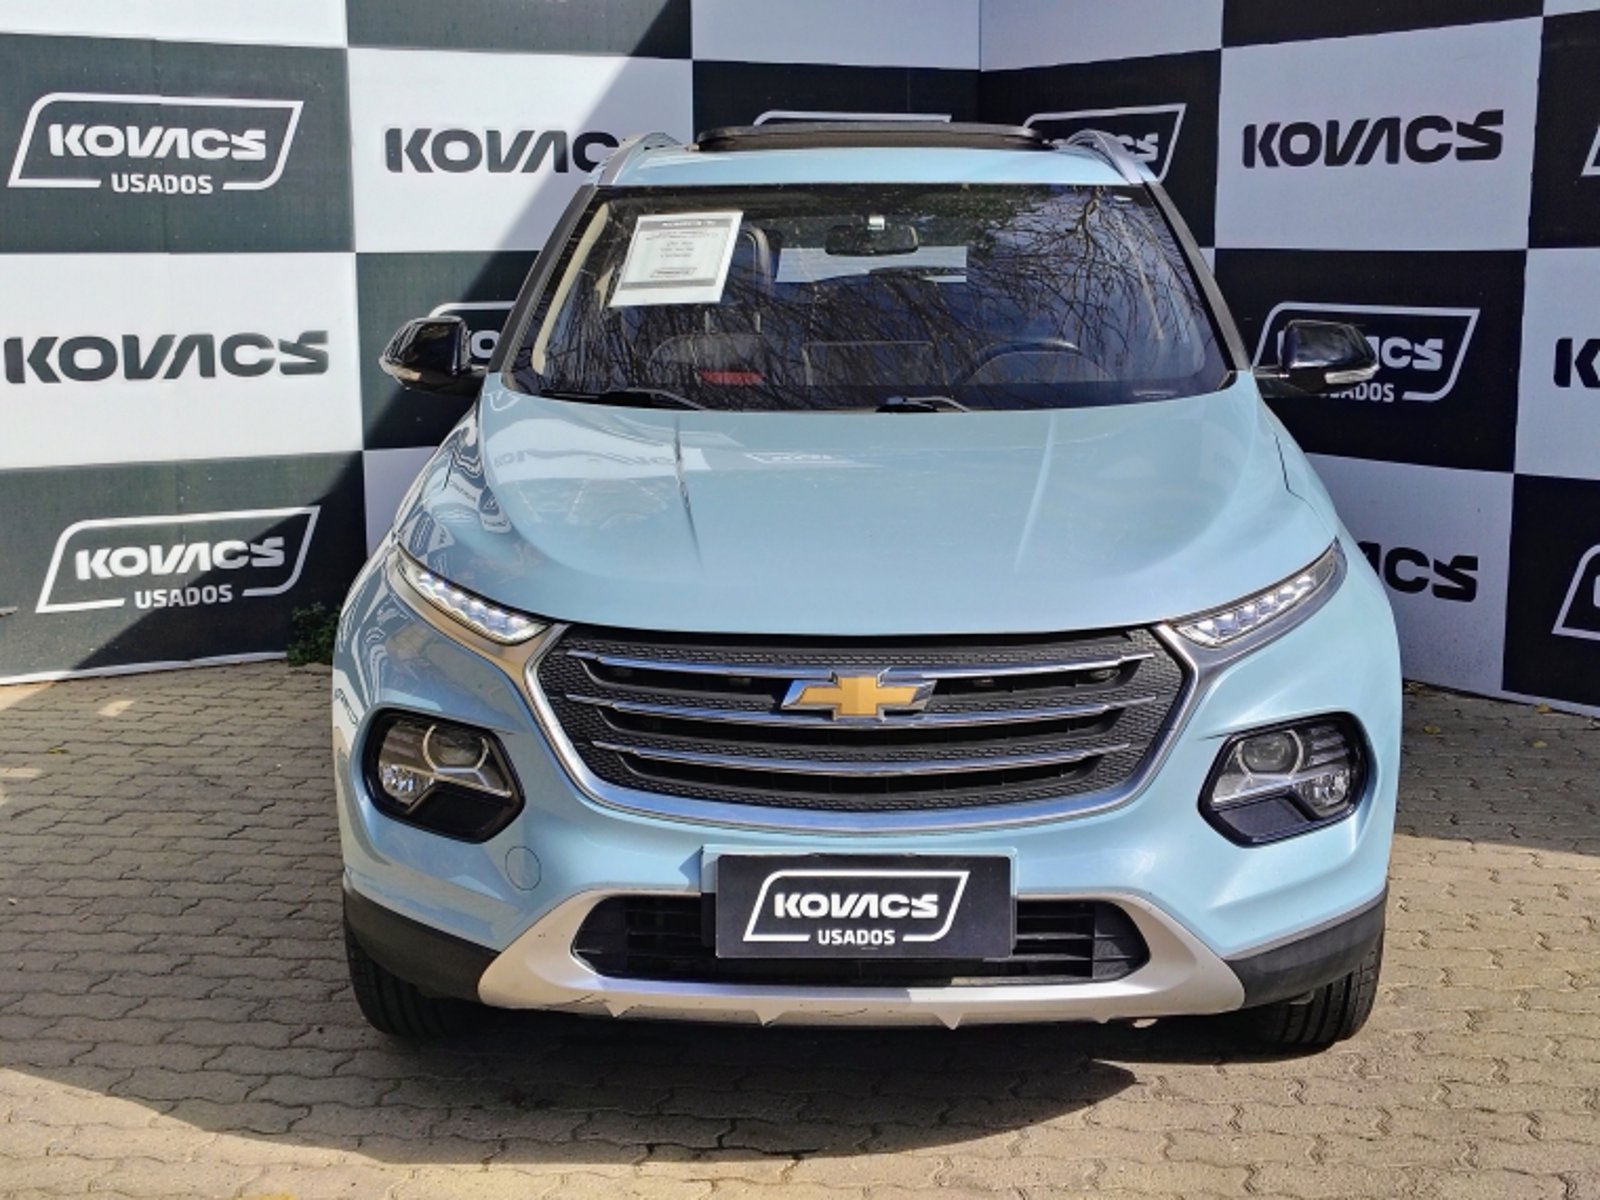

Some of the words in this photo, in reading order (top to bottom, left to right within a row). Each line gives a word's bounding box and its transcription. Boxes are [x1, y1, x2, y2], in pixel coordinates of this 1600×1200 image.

[48, 123, 266, 160] KOVACS
[1242, 109, 1504, 168] KOVACS
[110, 173, 213, 194] USADOS
[4, 330, 329, 383] KOVACS
[75, 536, 285, 580] KOVACS
[134, 584, 233, 609] USADOS
[774, 893, 938, 918] KOVACS
[817, 929, 895, 945] USADOS
